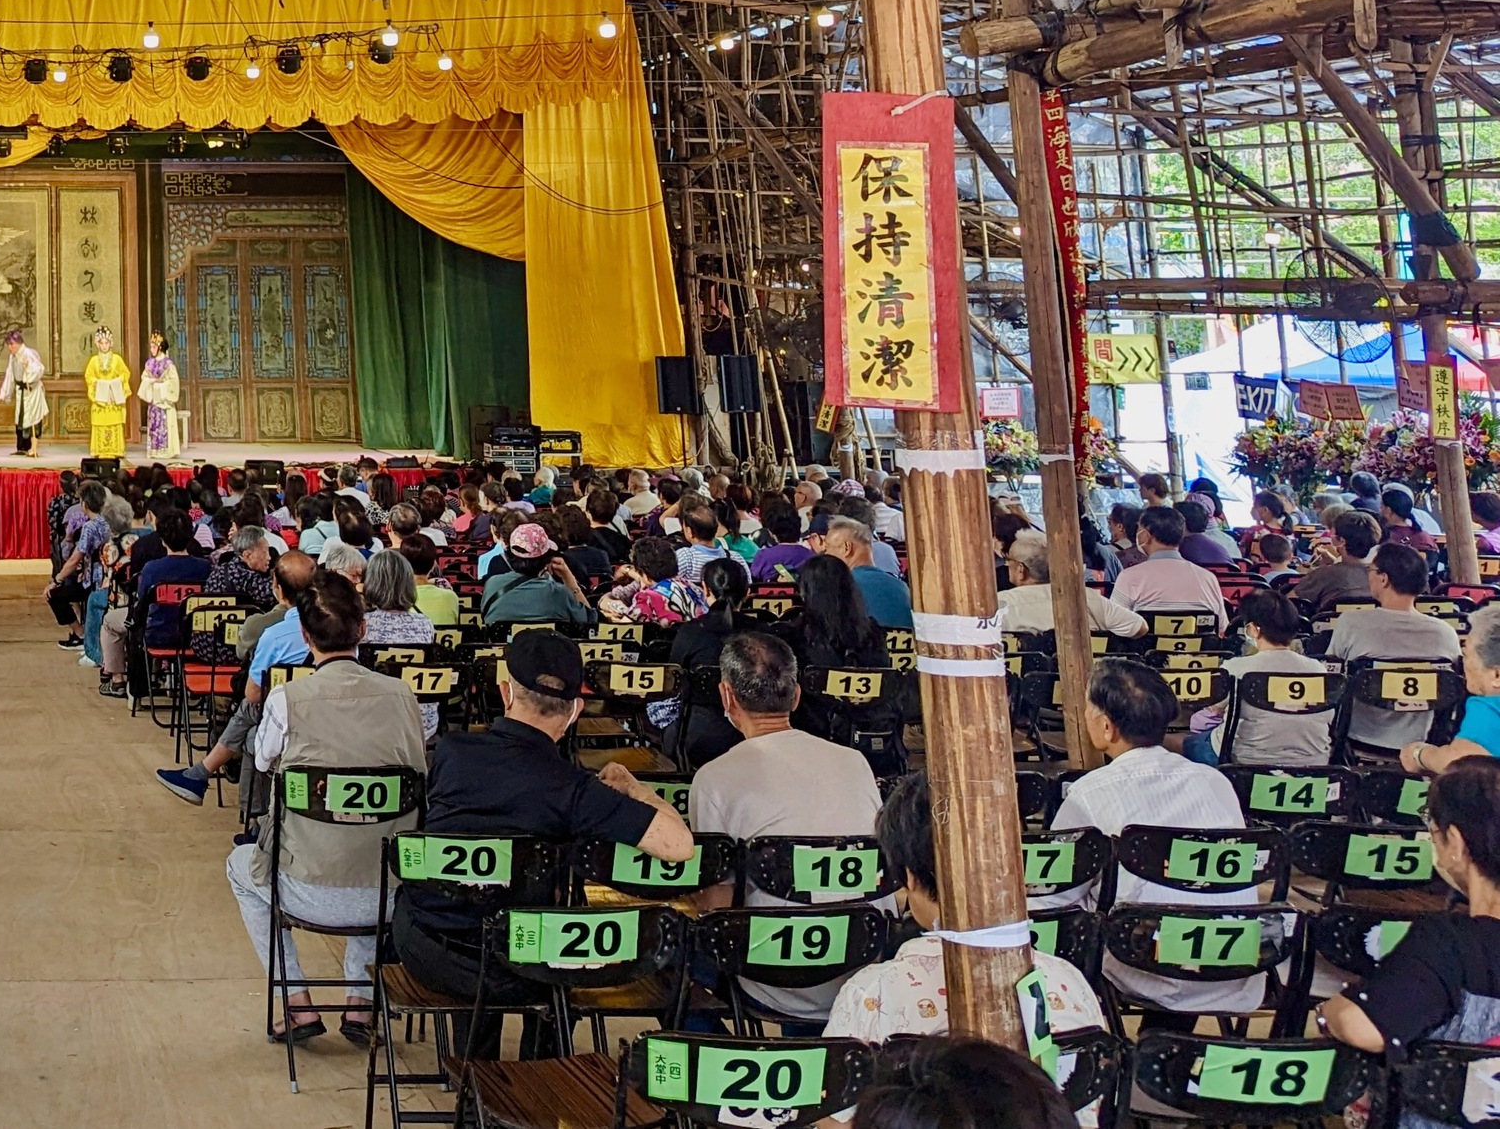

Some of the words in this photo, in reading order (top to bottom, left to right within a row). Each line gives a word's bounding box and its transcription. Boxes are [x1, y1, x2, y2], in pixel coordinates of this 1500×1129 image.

[851, 153, 914, 391] 保持清潔
[1236, 383, 1275, 414] EXIT
[1435, 368, 1451, 436] 遵守秩序
[607, 627, 635, 641] 14
[1170, 619, 1183, 634] 7
[412, 672, 444, 691] 17
[622, 669, 654, 689] 15
[838, 676, 871, 695] 13
[1169, 676, 1202, 696] 10
[1288, 680, 1306, 700] 9
[1402, 677, 1419, 697] 8
[342, 782, 389, 809] 20
[1268, 782, 1314, 808] 14
[440, 845, 497, 877] 20
[810, 856, 863, 888] 18
[1188, 849, 1241, 878] 16
[1368, 844, 1420, 875] 15
[560, 921, 622, 958] 20
[770, 925, 831, 961] 19
[1181, 926, 1244, 961] 17
[655, 1054, 667, 1085] 大堂中
[669, 1062, 681, 1080] (四)
[720, 1058, 802, 1101] 20
[1231, 1058, 1310, 1098] 18
